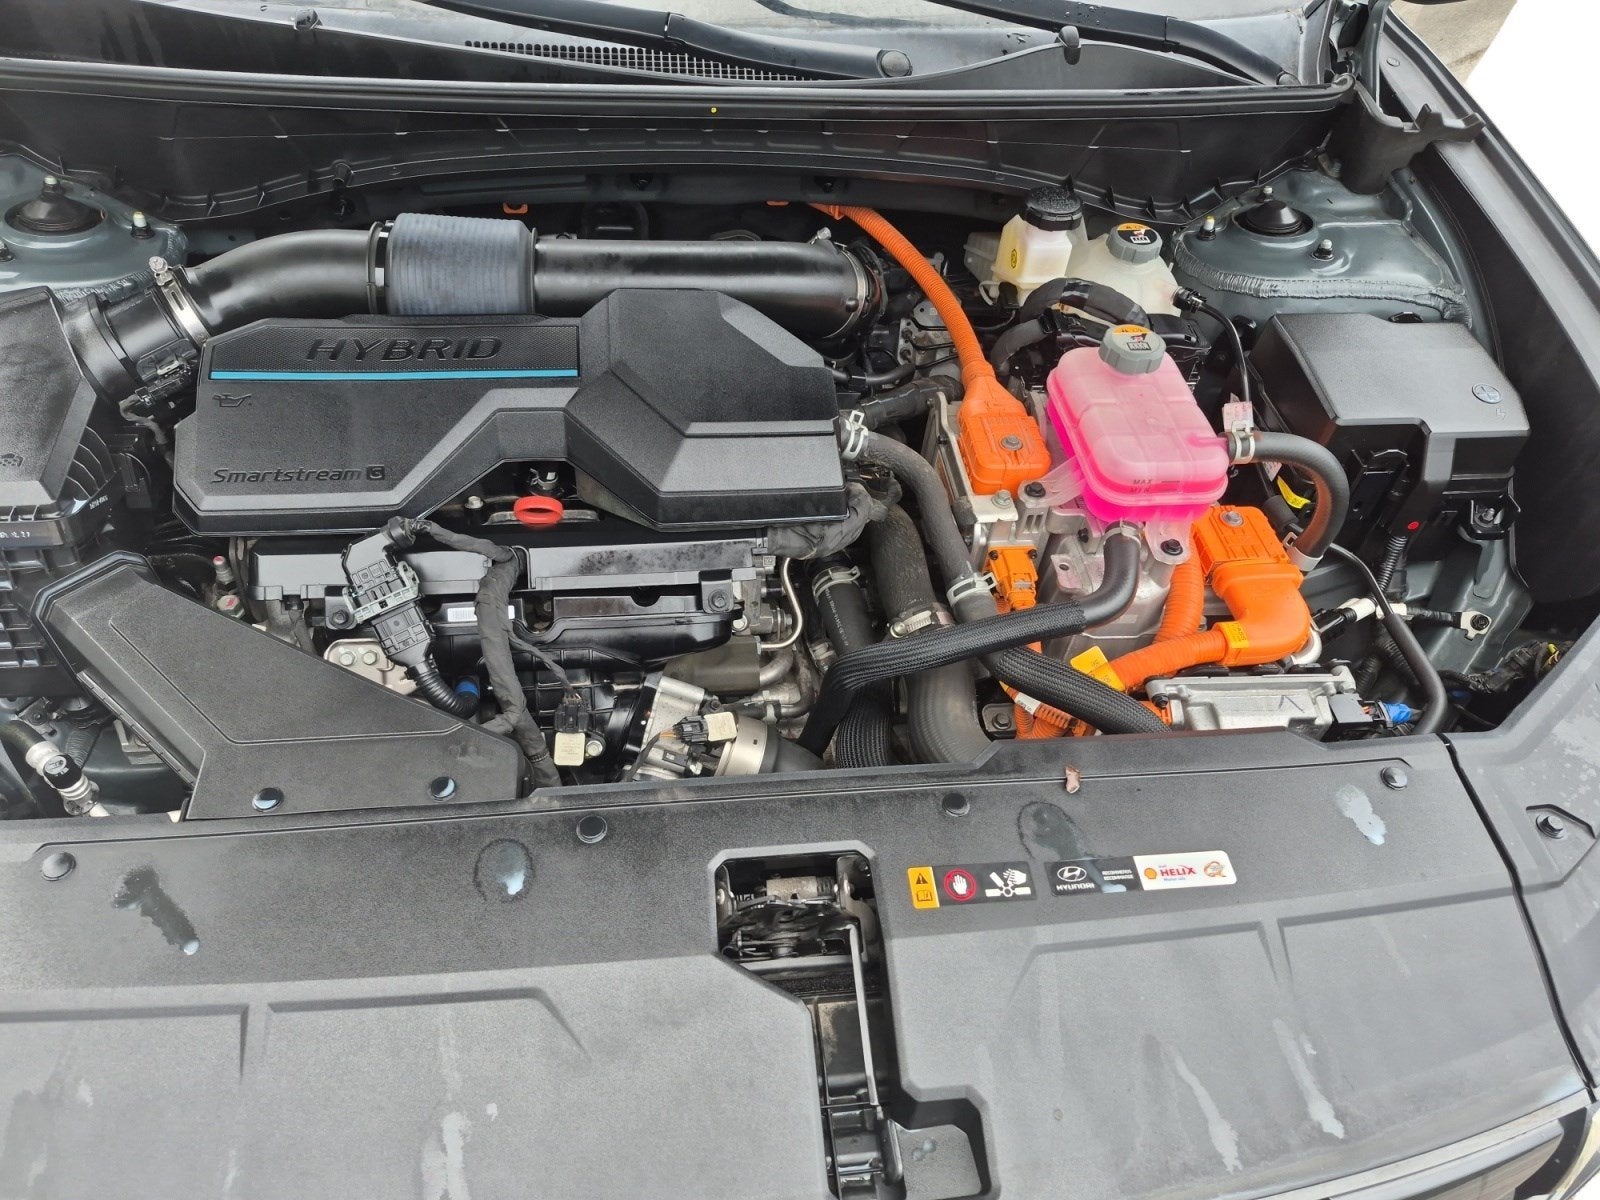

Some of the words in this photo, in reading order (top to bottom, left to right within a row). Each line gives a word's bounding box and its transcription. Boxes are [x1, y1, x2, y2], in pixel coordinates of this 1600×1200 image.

[307, 336, 501, 362] HYBRID
[212, 468, 360, 484] Smartstream
[1160, 866, 1197, 877] HELIX
[1056, 882, 1095, 891] HYUNDAI
